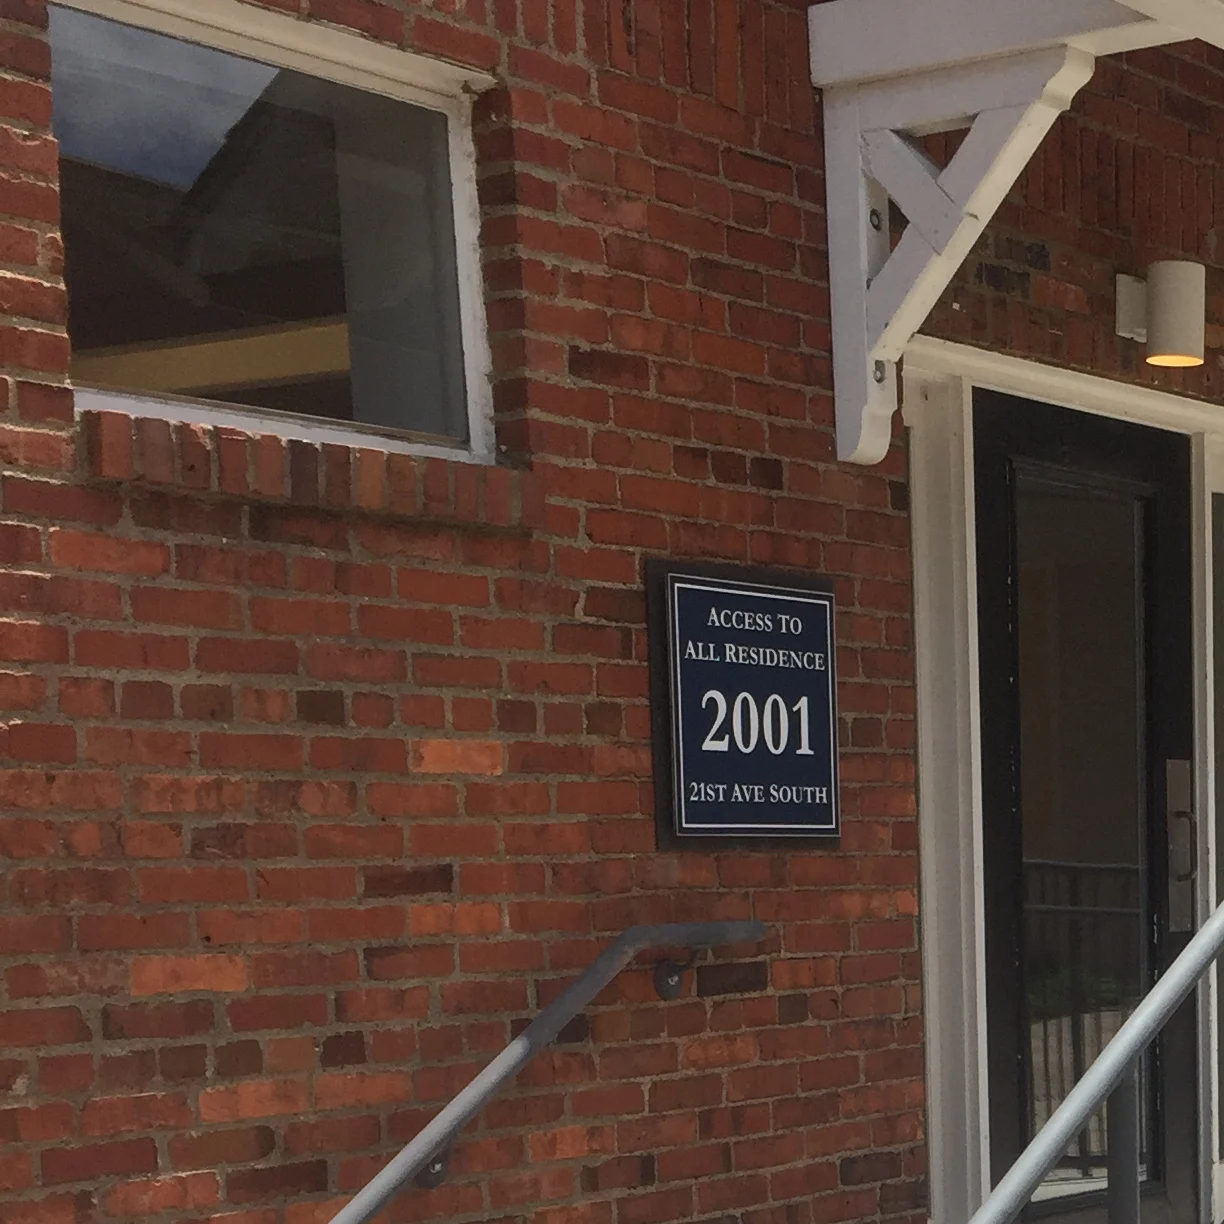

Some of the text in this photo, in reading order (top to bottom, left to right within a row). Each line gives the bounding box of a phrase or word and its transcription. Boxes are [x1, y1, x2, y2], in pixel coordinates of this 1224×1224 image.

[707, 607, 802, 635] ACCESS TO
[685, 641, 825, 671] ALL RESIDENCE
[701, 689, 815, 755] 2001
[690, 781, 828, 804] 21ST AVE SOUTH
